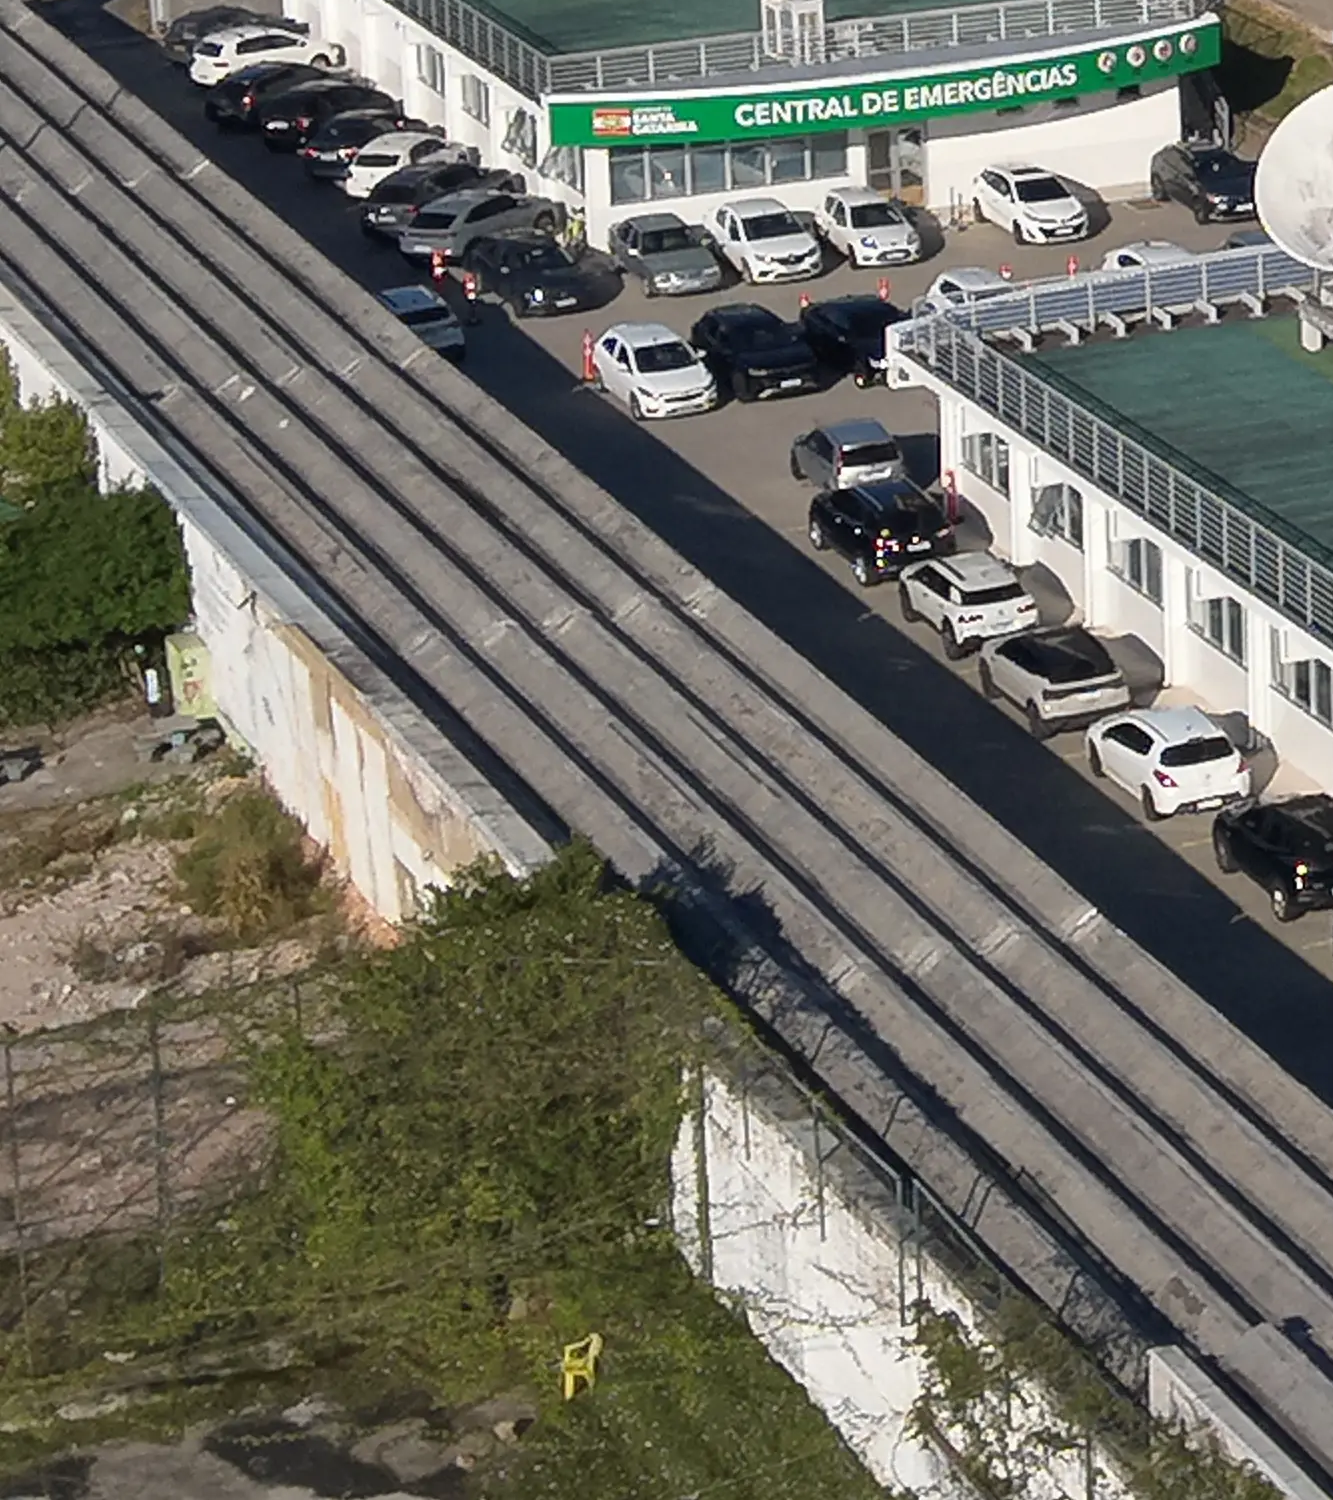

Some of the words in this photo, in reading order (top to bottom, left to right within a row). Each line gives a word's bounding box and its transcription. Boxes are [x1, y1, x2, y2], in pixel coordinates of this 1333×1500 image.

[734, 95, 858, 127] CENTRAL
[862, 91, 899, 116] DE
[904, 63, 1078, 111] EMERGÊNCIAS
